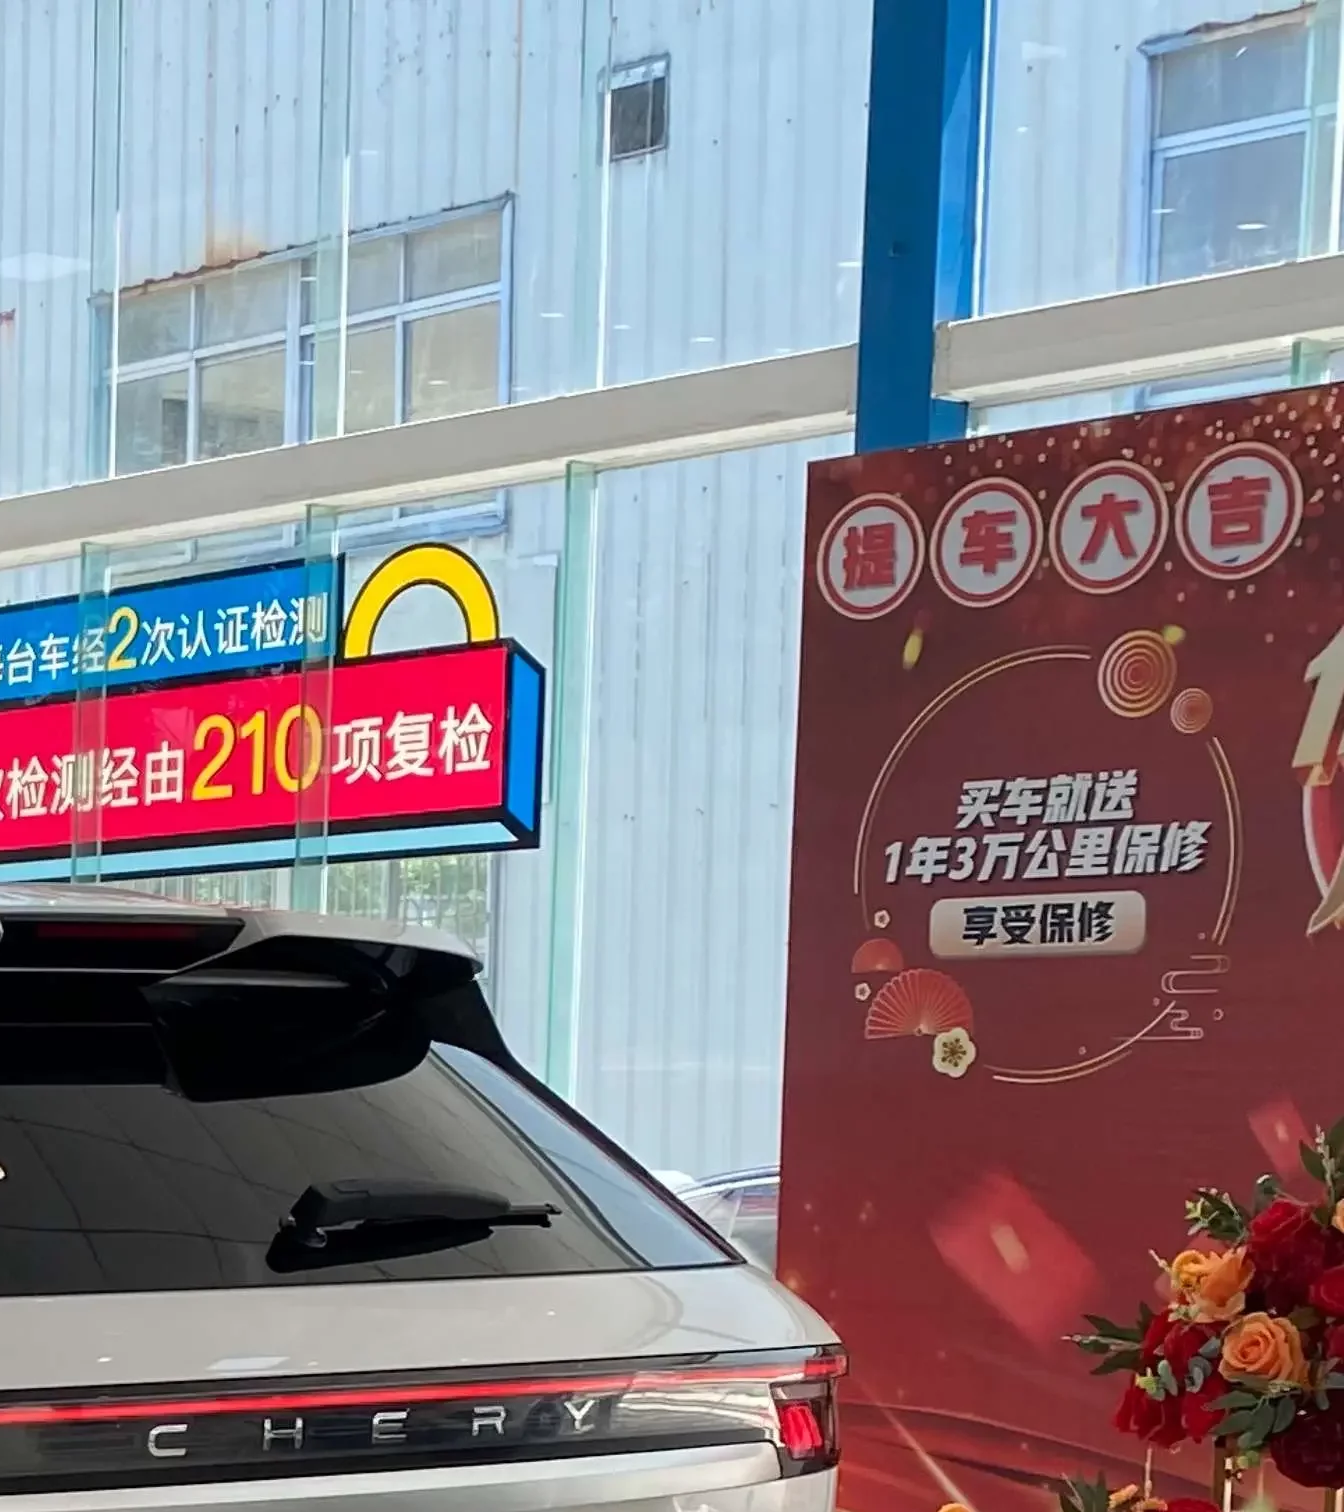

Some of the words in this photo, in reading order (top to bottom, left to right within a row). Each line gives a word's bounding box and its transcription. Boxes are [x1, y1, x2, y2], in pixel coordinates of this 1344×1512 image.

[842, 474, 1271, 591] 提车大吉
[955, 768, 1139, 829] 买车就送
[882, 820, 1213, 884] 1年3万公里保修
[961, 901, 1116, 948] 享受保修
[147, 1399, 597, 1459] CHERY
